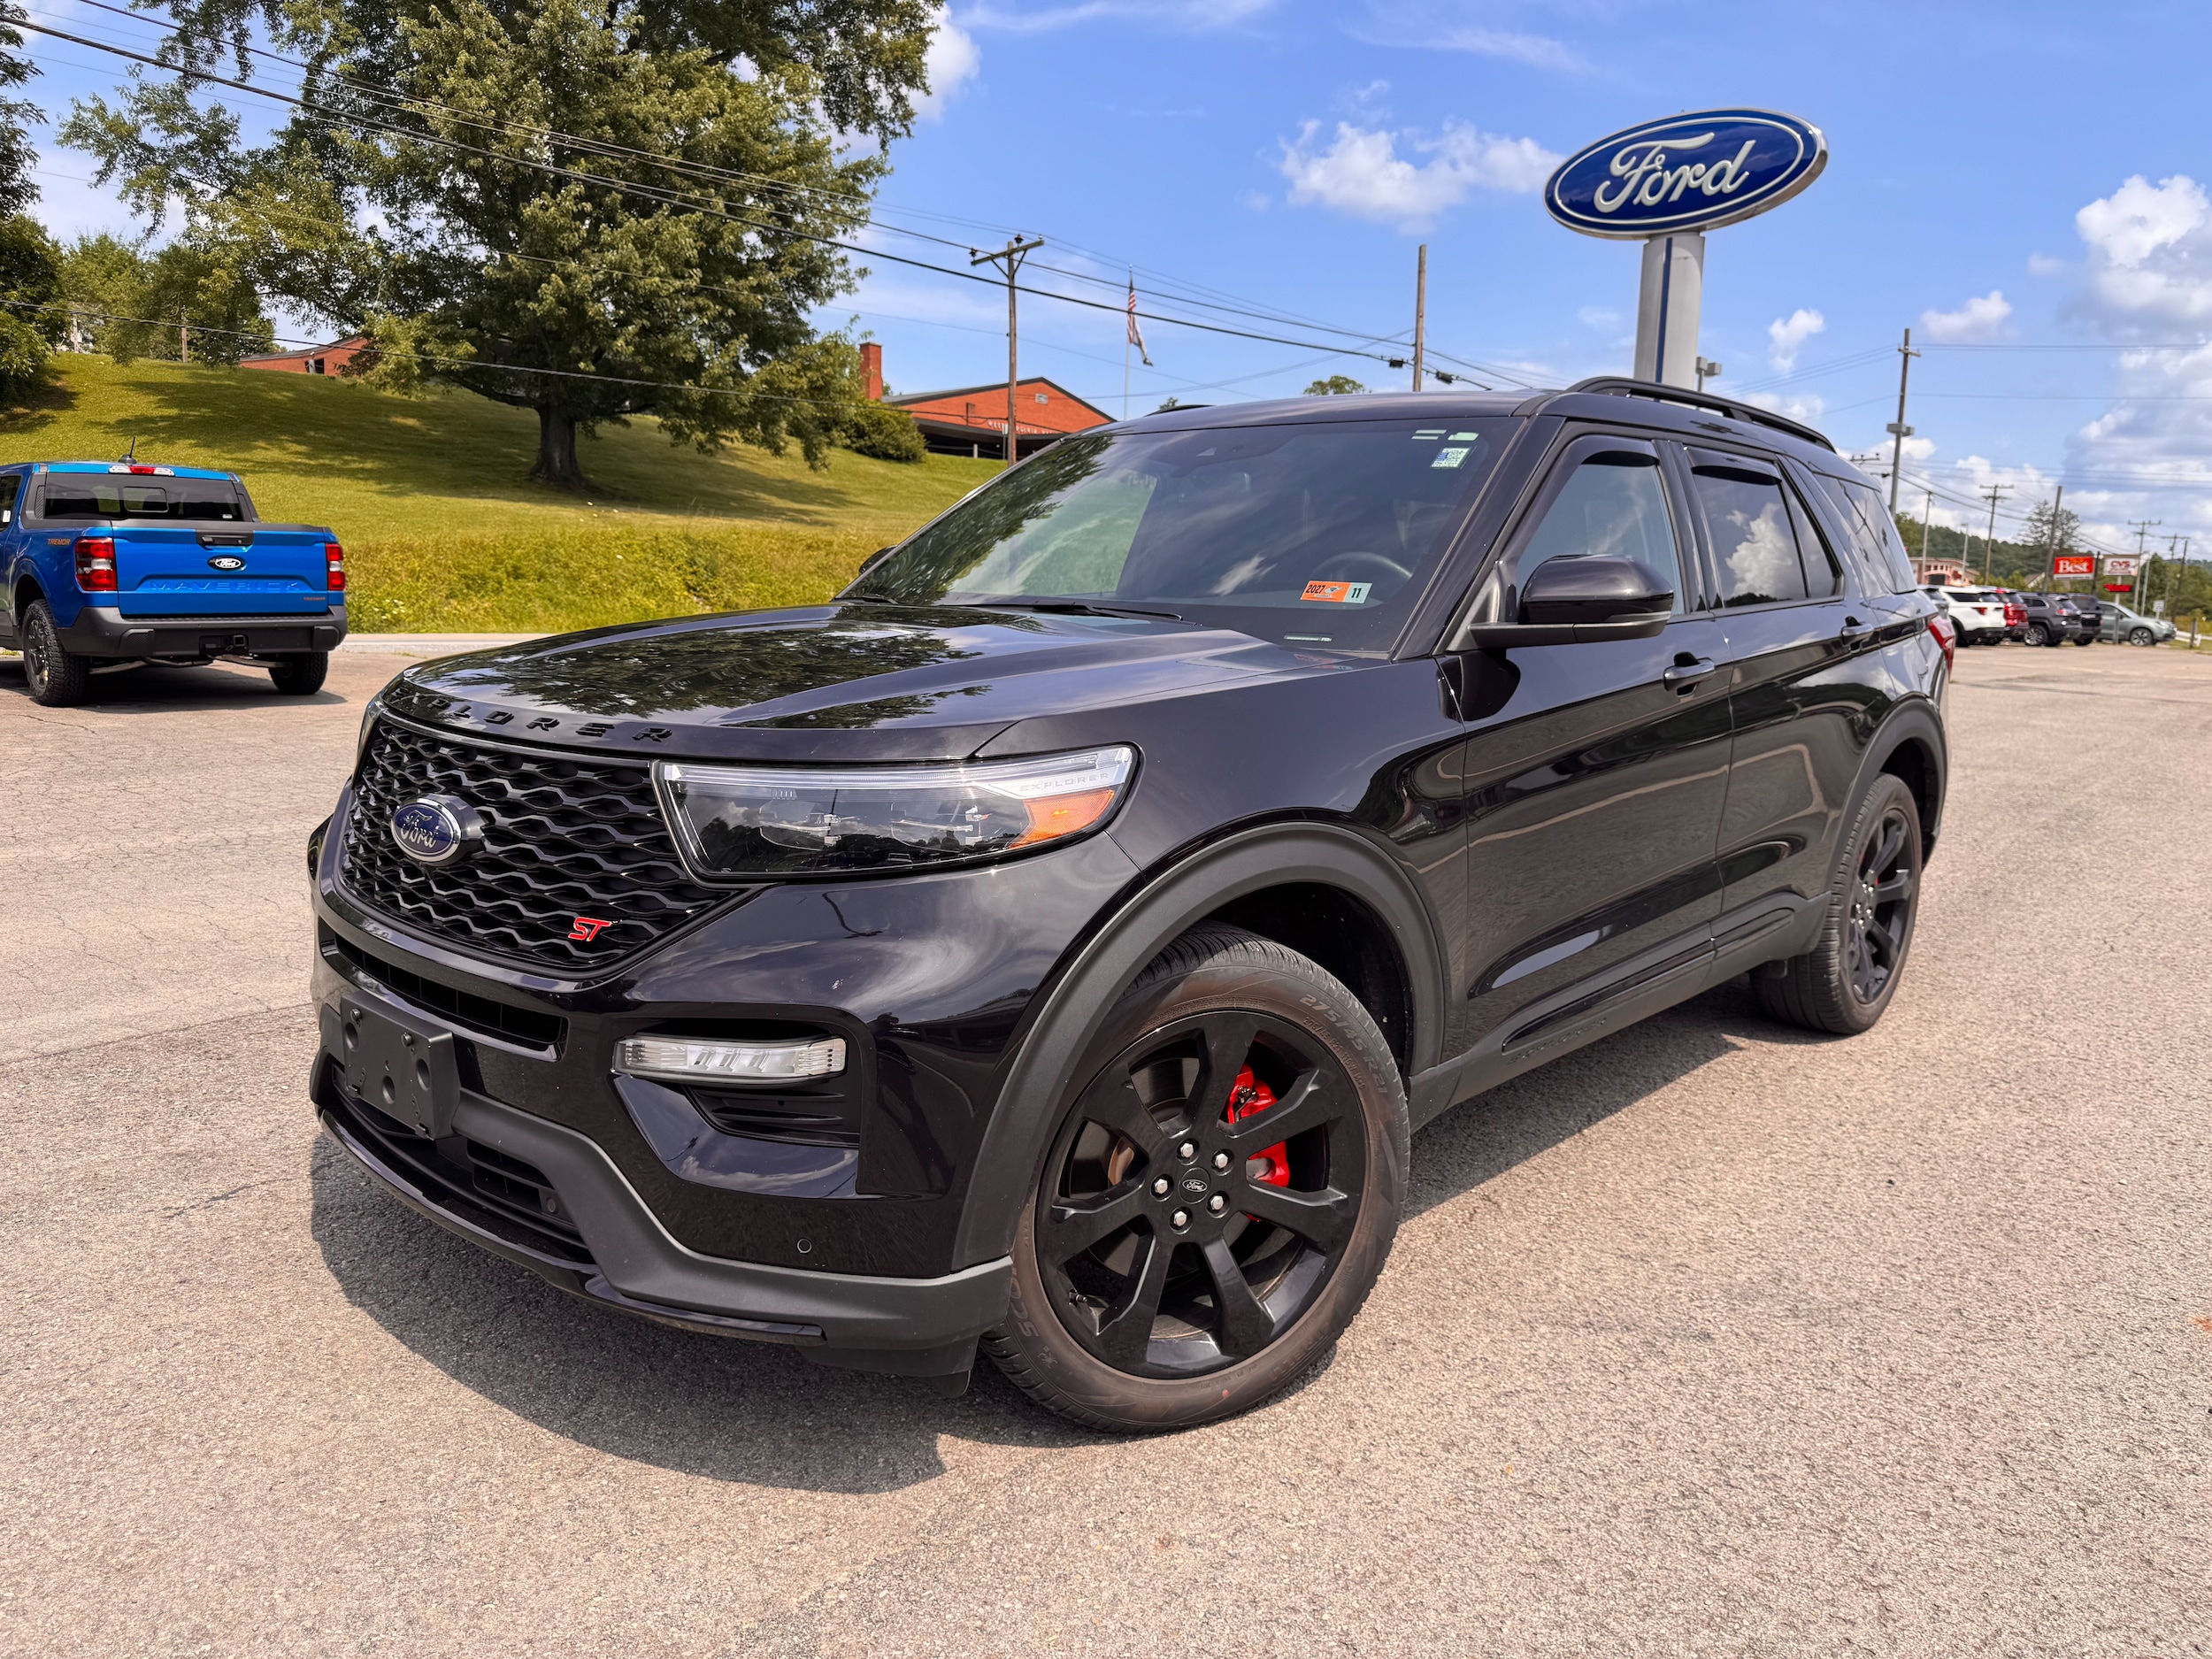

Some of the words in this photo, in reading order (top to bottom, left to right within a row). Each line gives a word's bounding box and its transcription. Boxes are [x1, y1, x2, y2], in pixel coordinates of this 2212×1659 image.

[1594, 133, 1756, 213] Ford
[2057, 560, 2089, 573] Best
[150, 578, 300, 591] MAVERICK
[1306, 584, 1325, 594] 2027
[1351, 588, 1363, 598] 11
[1020, 772, 1109, 792] EXPLORER
[401, 809, 438, 848] Ford
[567, 916, 612, 942] ST
[1186, 1180, 1204, 1190] Ford
